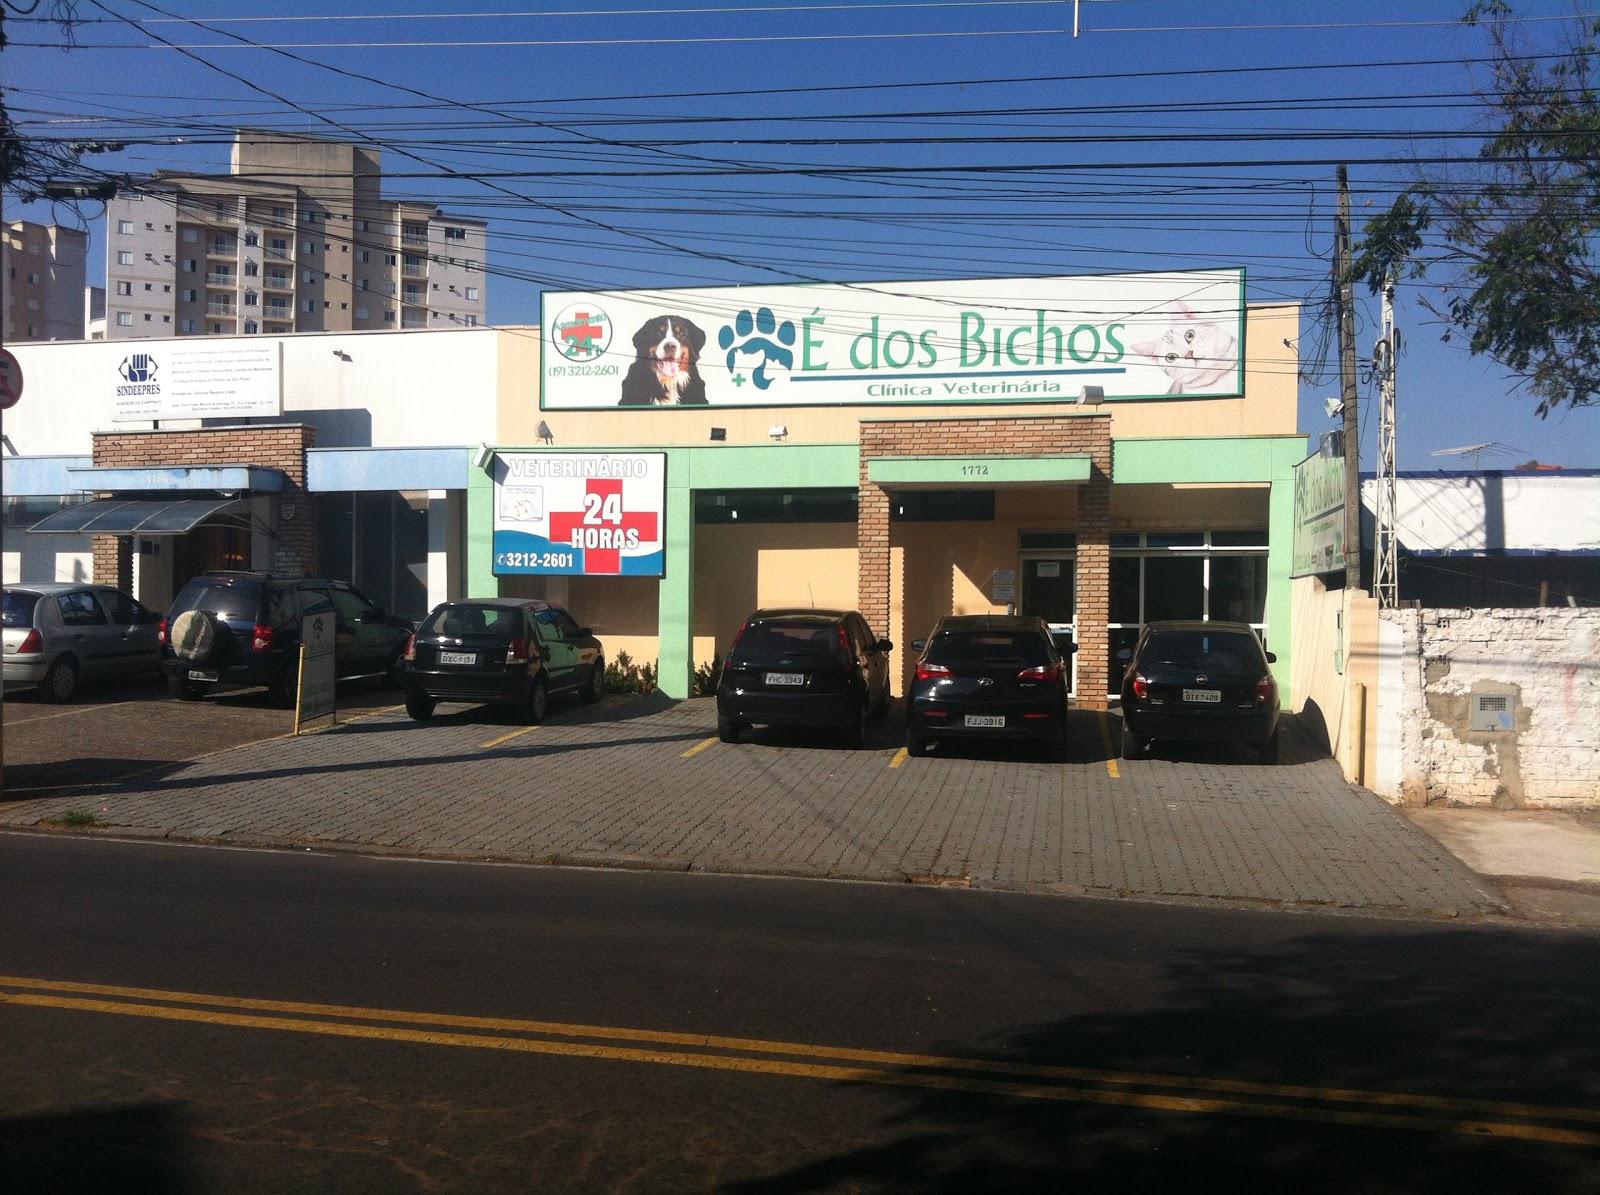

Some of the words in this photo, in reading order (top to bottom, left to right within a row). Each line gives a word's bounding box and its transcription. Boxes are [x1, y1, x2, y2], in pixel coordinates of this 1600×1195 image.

[801, 306, 829, 372] É
[849, 315, 938, 370] dos
[959, 309, 1126, 368] Bichos
[567, 365, 619, 376] 3212-2601
[116, 384, 161, 397] SINDEEPRES
[867, 383, 932, 397] Clínica
[942, 379, 1061, 395] Veterinária
[509, 455, 648, 478] VETERINÁRIO
[961, 465, 989, 475] 1772
[583, 493, 622, 526] 24
[571, 528, 639, 550] HORAS
[506, 553, 573, 567] 3212-2601
